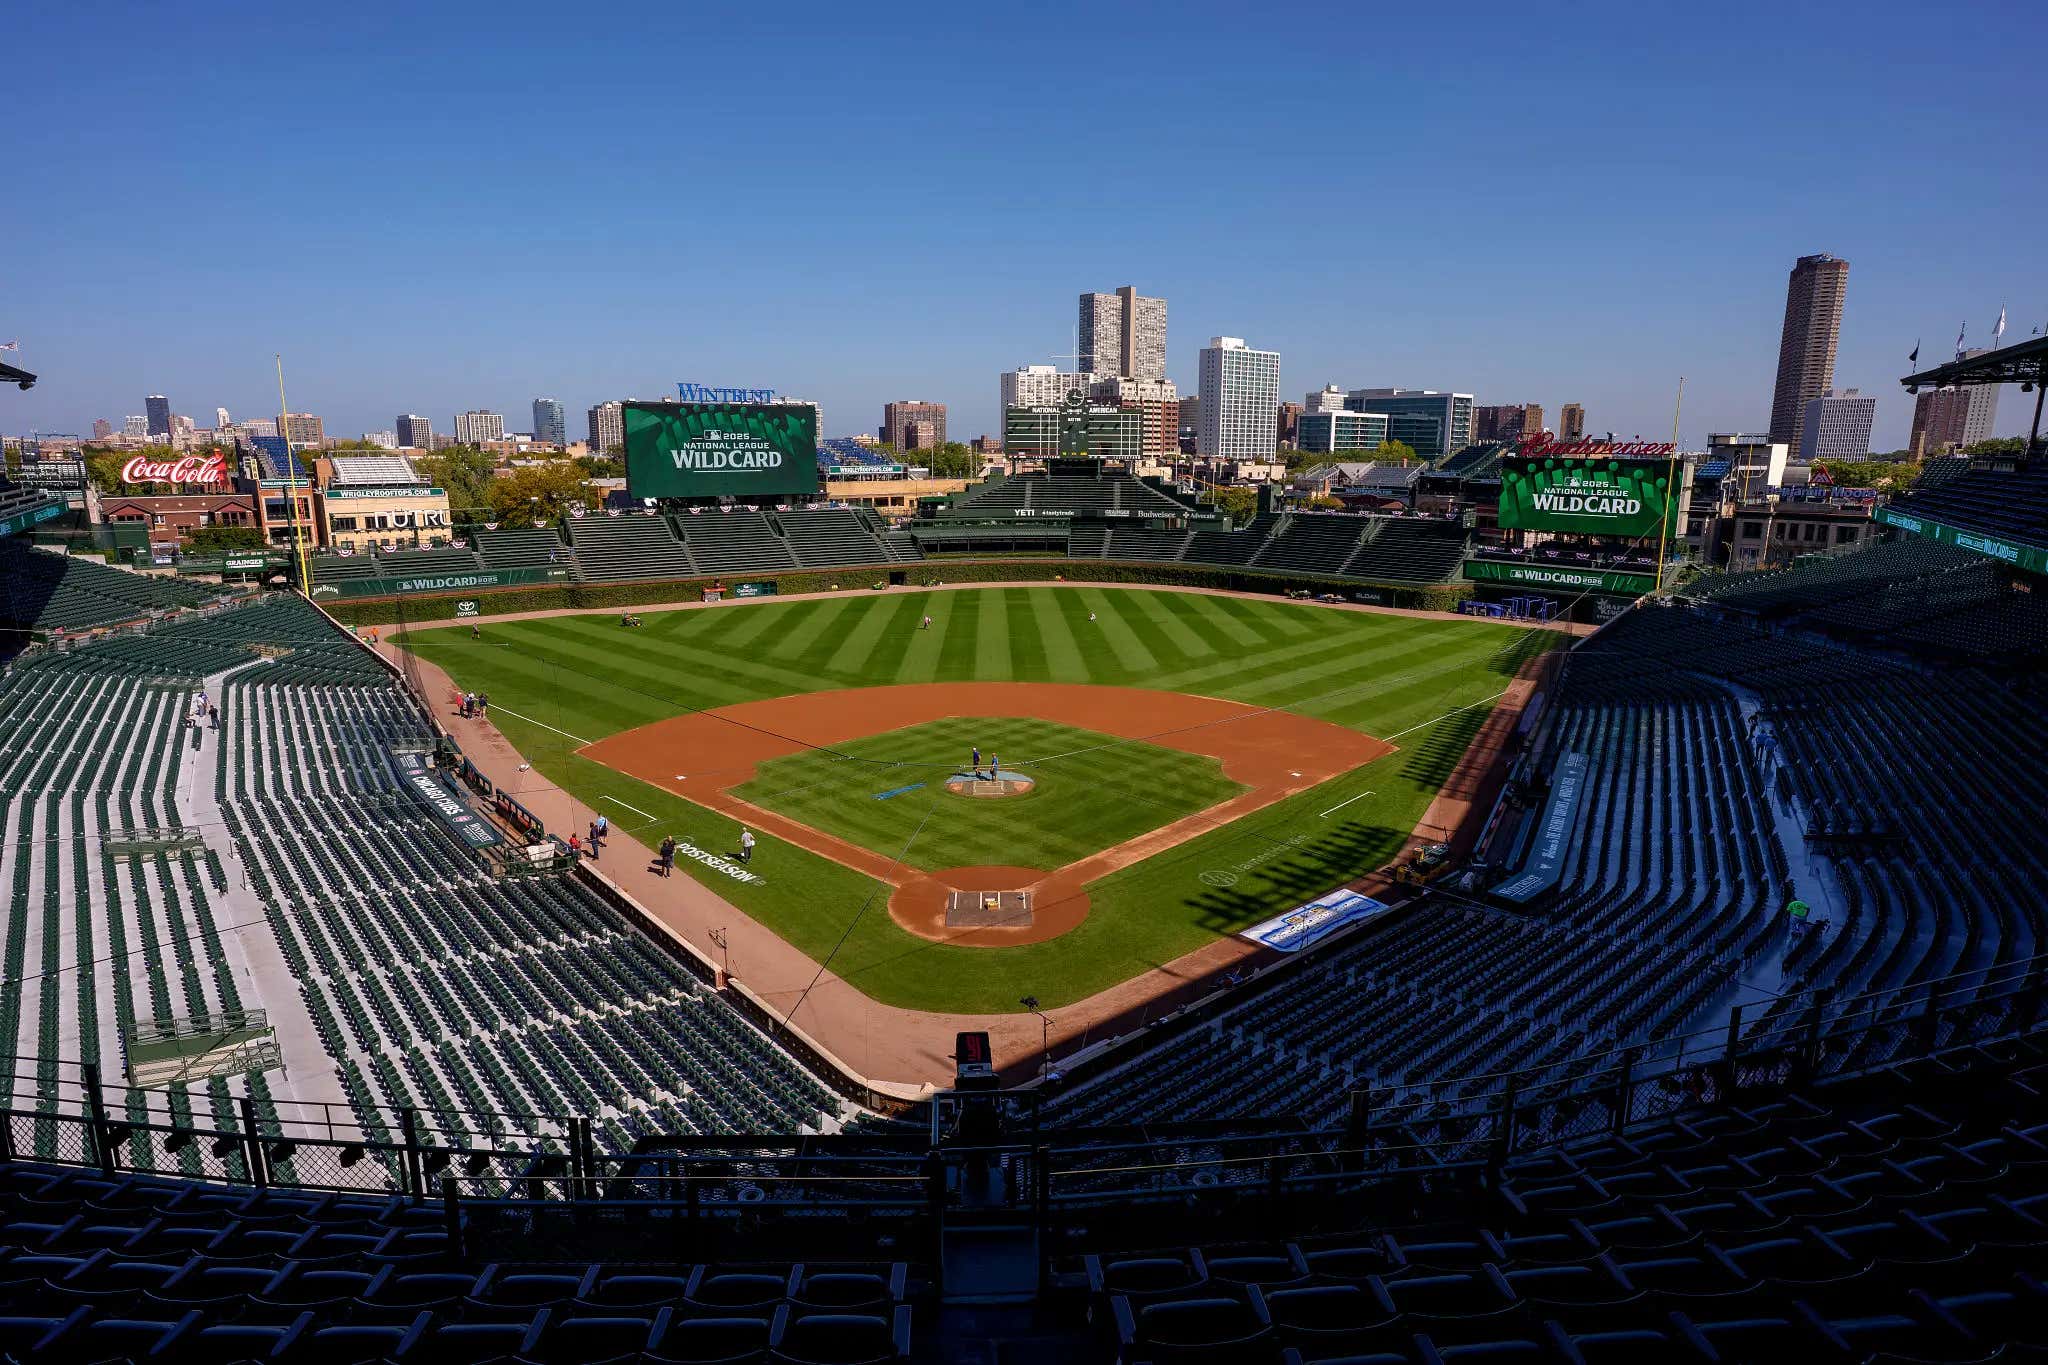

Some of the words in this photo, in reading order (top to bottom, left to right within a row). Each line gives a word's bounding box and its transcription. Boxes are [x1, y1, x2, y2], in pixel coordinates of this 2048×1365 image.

[677, 382, 775, 404] WINTRUST
[1517, 431, 1677, 456] Budweiser
[670, 450, 726, 468] WILD
[728, 450, 782, 468] CARD
[122, 456, 224, 484] Coca-Cola
[1582, 480, 1609, 488] 2025
[340, 488, 430, 498] WRIGLEYROOFTOPS.COM
[1544, 487, 1588, 495] NATIONAL
[1591, 488, 1628, 497] LEAGUE
[1831, 486, 1877, 498] Moore
[1532, 494, 1583, 512] WILD
[1584, 496, 1641, 515] CARD
[1137, 510, 1176, 518] Budweiser
[413, 579, 445, 590] WILD
[445, 576, 477, 588] CARD
[1524, 569, 1551, 581] WILD
[1552, 572, 1581, 584] CARD
[322, 585, 339, 594] BEAM
[412, 776, 447, 799] CHICAGO
[434, 798, 464, 816] CUBS
[680, 842, 756, 882] POSTSEASON
